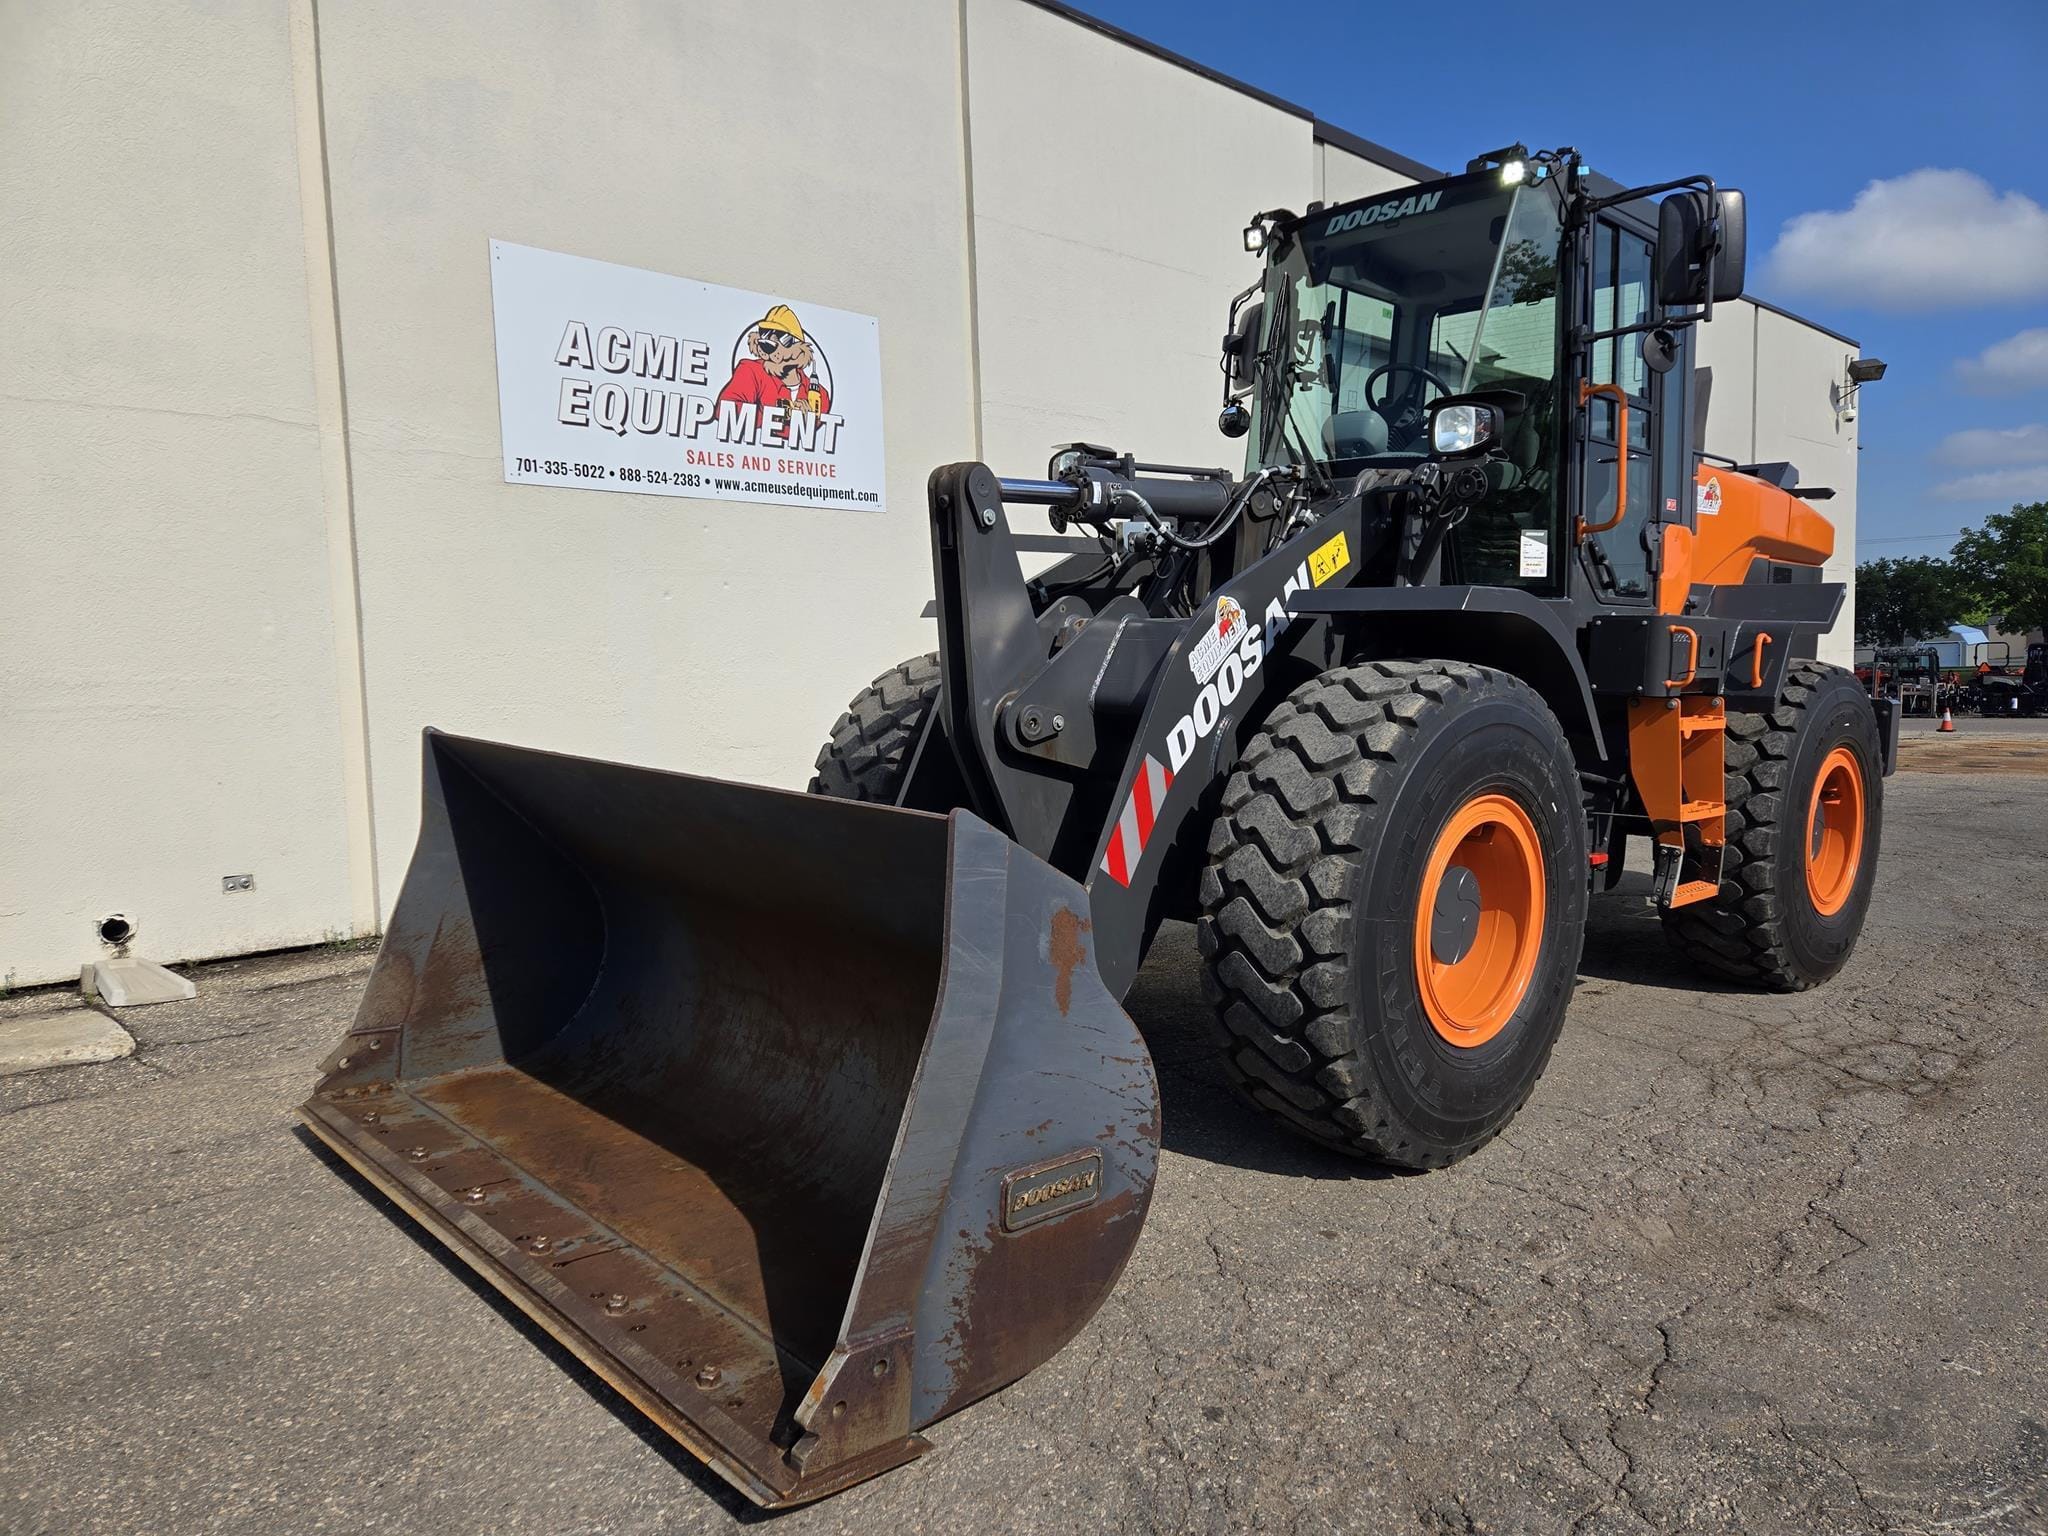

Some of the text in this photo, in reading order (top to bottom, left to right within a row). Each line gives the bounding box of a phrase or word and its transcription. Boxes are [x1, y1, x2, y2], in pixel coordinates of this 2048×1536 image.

[1325, 190, 1443, 237] DOOSAN
[554, 320, 710, 386] ACME
[557, 376, 845, 455] EQUIPMENT
[516, 457, 879, 503] 701-335-5022 888-524-2383 www.acmeusedequipment.com
[686, 449, 837, 478] SALES AND SERVICE
[1190, 628, 1217, 669] ACME
[1196, 612, 1248, 682] EQUIPMENT
[1012, 1170, 1096, 1213] DOOSAN
